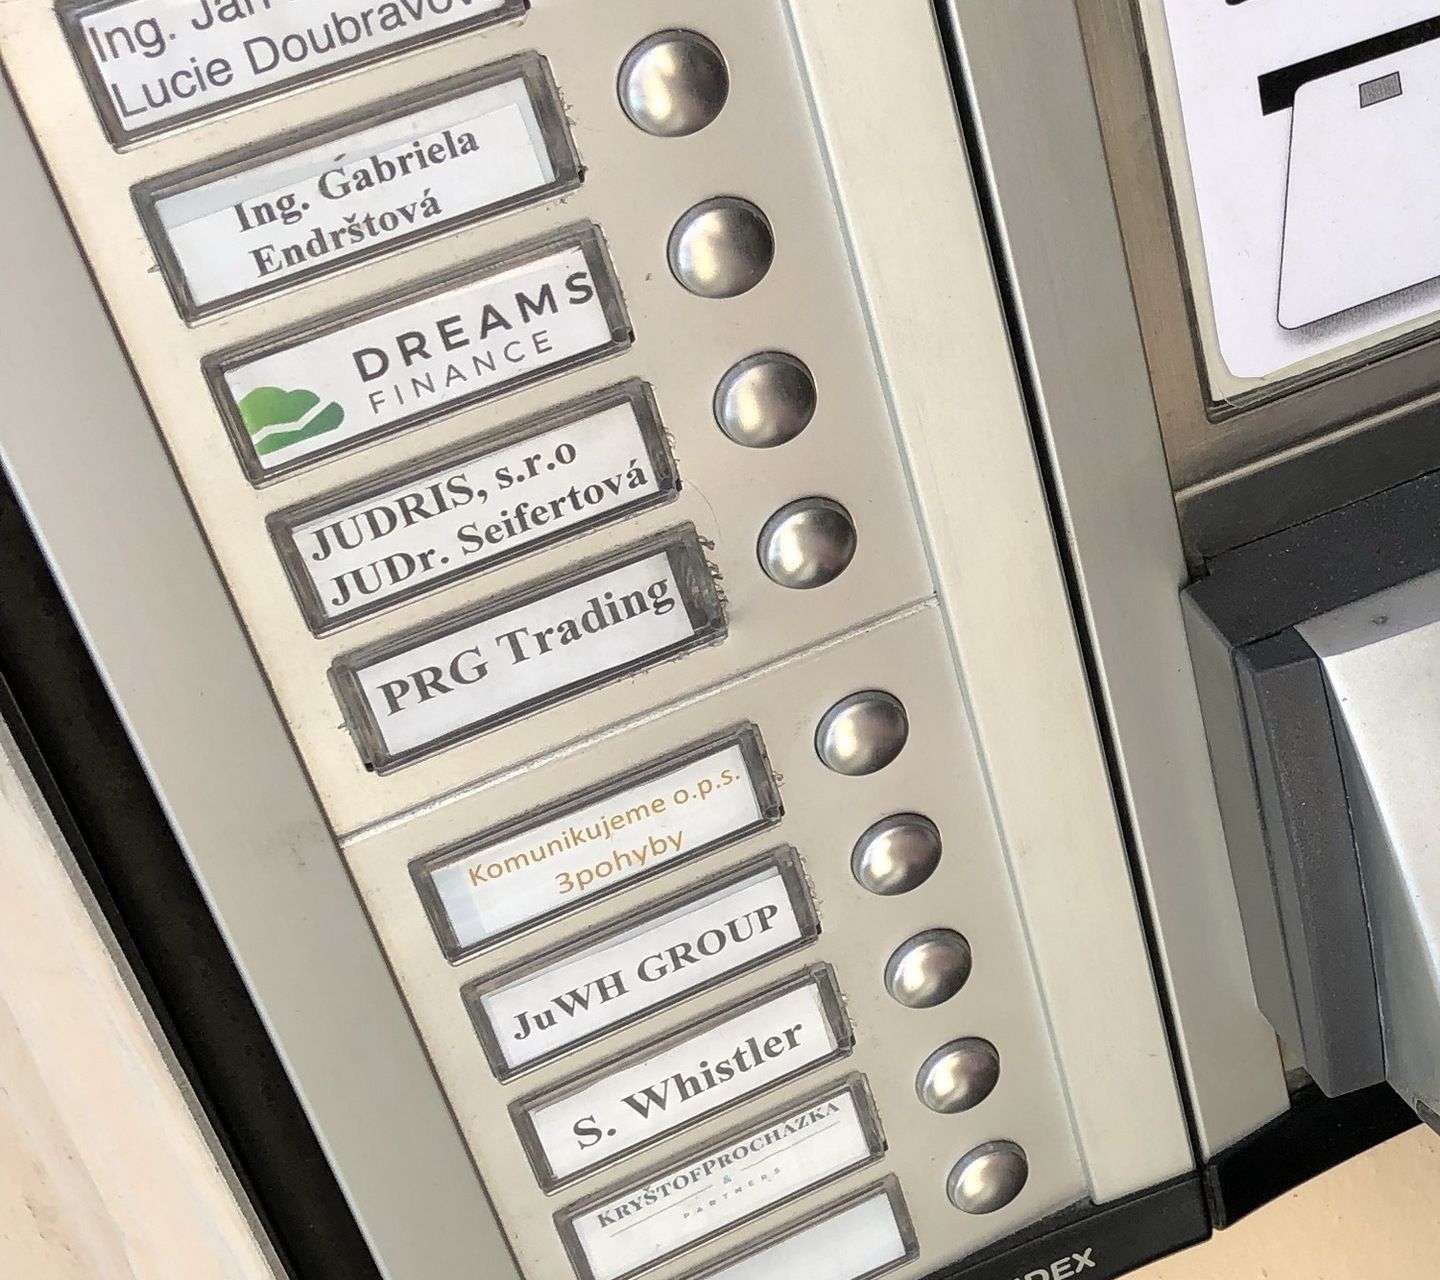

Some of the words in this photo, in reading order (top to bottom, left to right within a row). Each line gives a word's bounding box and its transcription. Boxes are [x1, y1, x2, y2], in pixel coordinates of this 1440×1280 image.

[88, 11, 177, 62] Ing.
[110, 57, 234, 120] Lucie
[232, 190, 310, 234] Ing.
[317, 128, 480, 202] Gabriela
[248, 187, 443, 280] Endrštová
[351, 271, 595, 384] DREAMS
[366, 328, 555, 414] FINANCE
[311, 473, 489, 561] JUDRIS,
[494, 441, 577, 490] s.r.o
[330, 546, 449, 607] JUDr.
[456, 459, 648, 555] Seifertová
[376, 645, 490, 716] PRG
[494, 576, 676, 667] Trading
[467, 798, 667, 887] Komunikujeme
[673, 773, 740, 812] o.p.s.
[554, 828, 685, 895] 3pohyby
[513, 969, 627, 1041] JuWH
[635, 903, 778, 982] GROUP
[571, 1114, 616, 1150] S.
[620, 1021, 804, 1120] Whistler
[683, 1166, 781, 1220] PARTNERS
[722, 1174, 732, 1185] &
